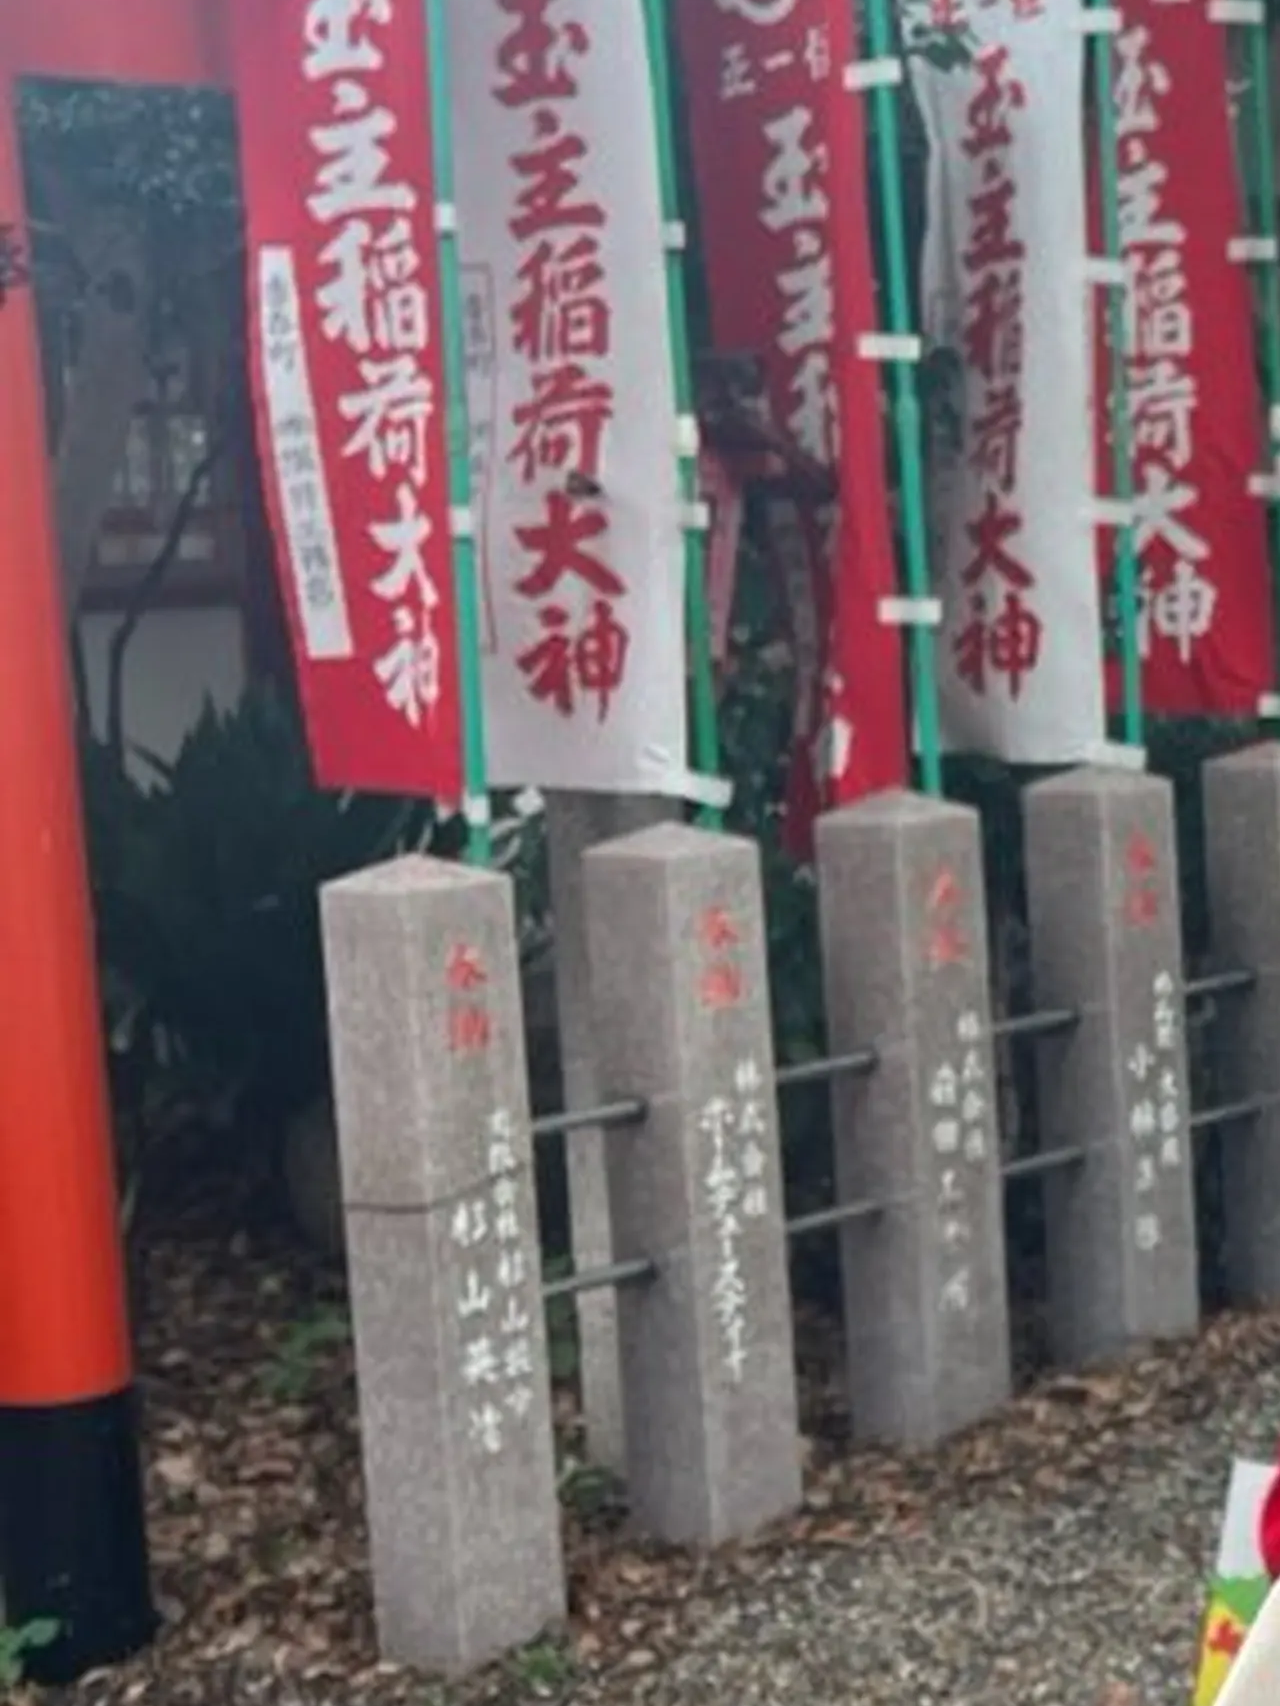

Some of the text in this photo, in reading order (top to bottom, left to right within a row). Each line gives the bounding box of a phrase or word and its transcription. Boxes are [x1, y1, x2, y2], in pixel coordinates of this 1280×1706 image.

[950, 45, 1044, 703] 玉主稲荷大神
